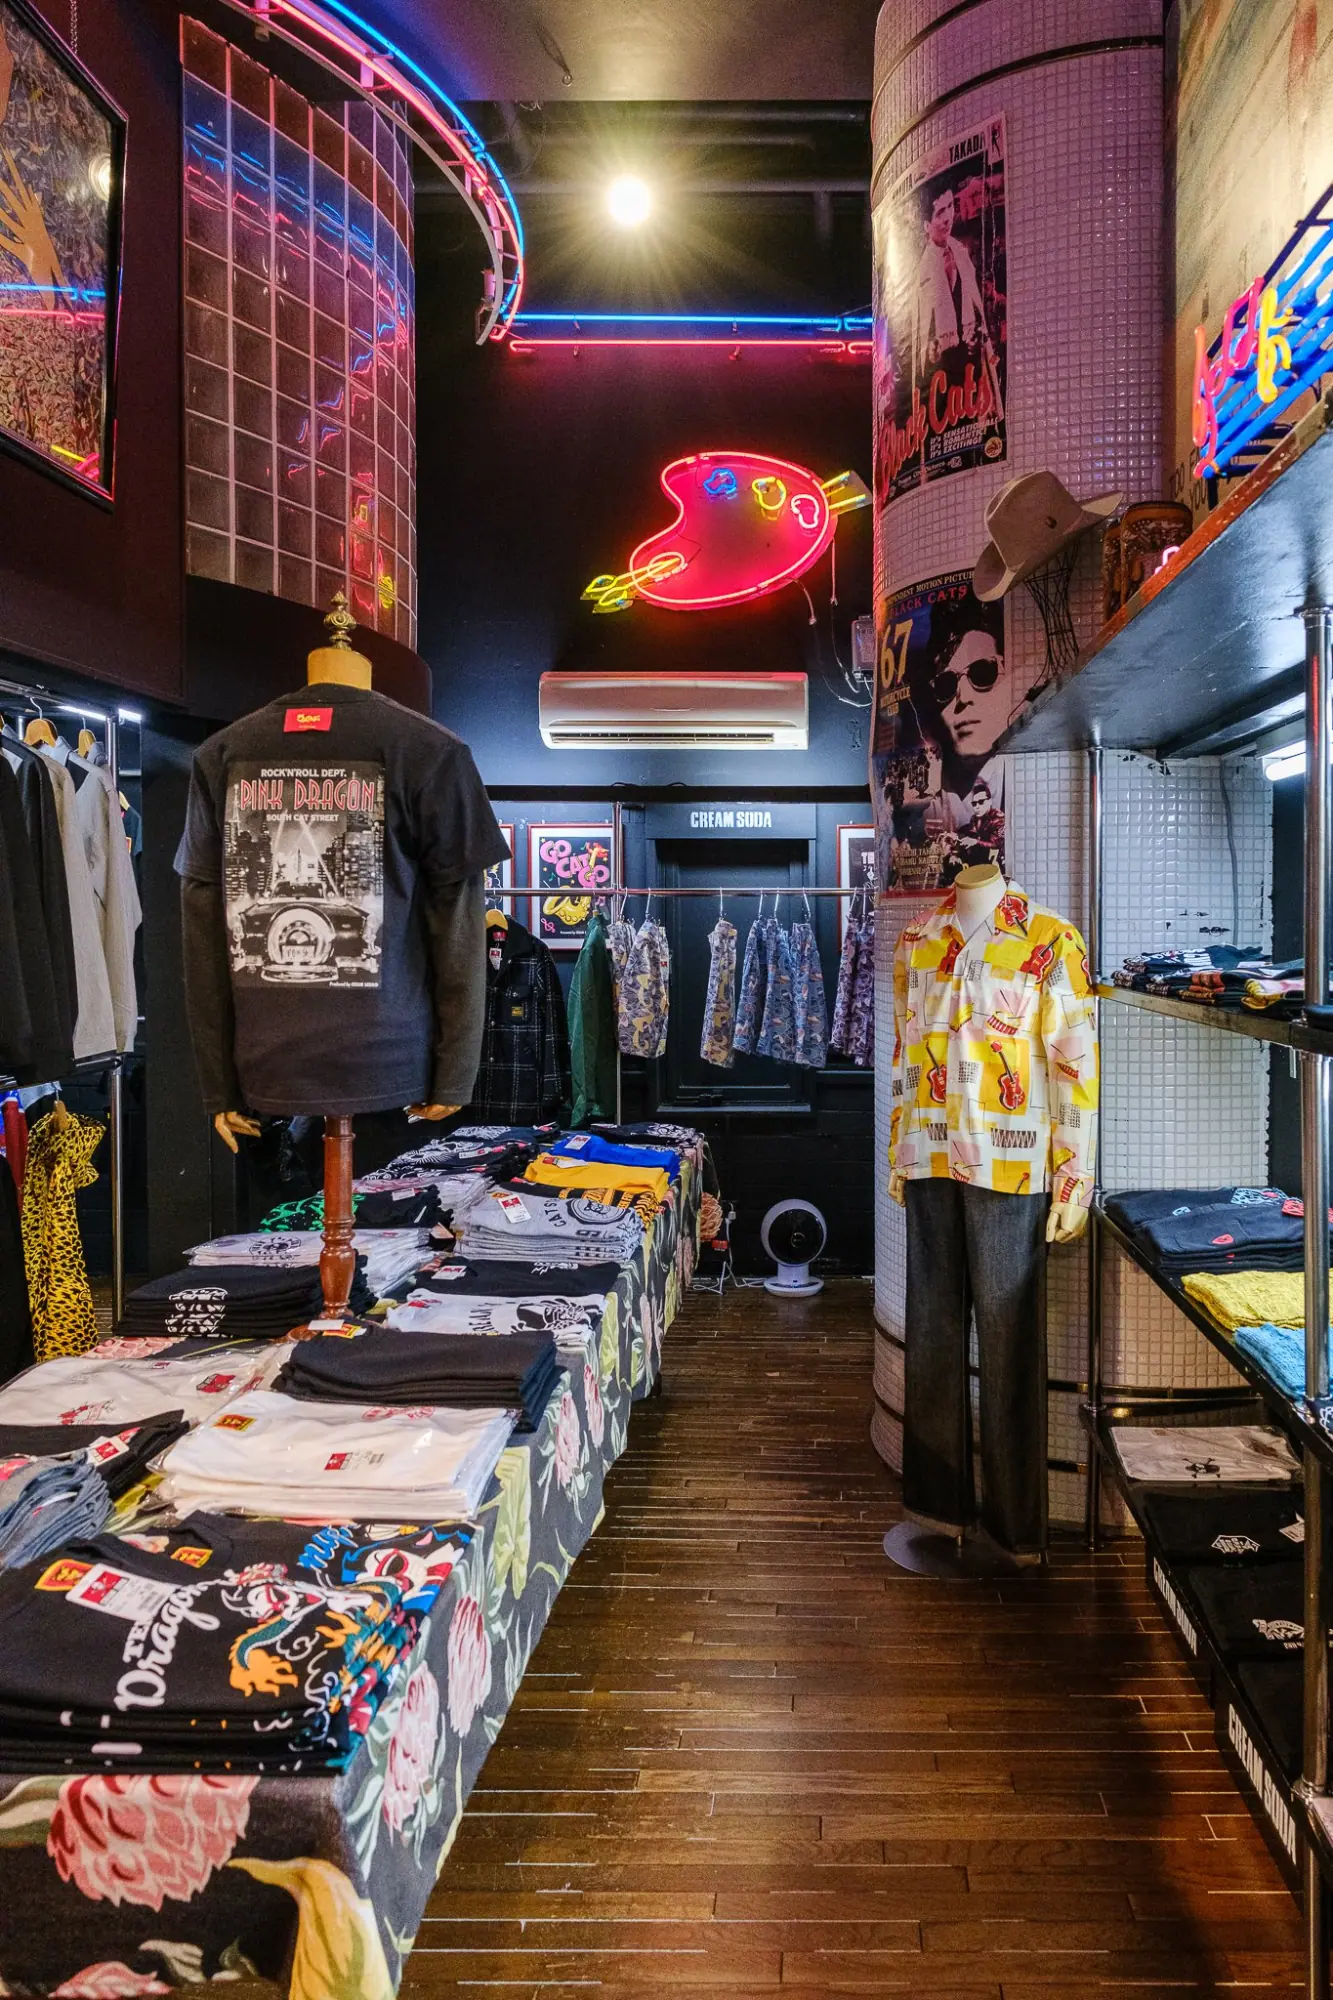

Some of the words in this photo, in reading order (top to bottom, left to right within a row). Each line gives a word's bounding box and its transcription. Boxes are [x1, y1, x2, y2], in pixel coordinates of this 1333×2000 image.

[944, 571, 974, 585] PICTUR
[881, 619, 914, 690] 67
[261, 768, 320, 778] ROCK'N'ROLL
[321, 768, 347, 778] DEPT.
[240, 778, 284, 811] PINK
[293, 778, 375, 812] DRAGON
[266, 814, 292, 822] SOUTH
[311, 814, 339, 822] STREET
[690, 811, 734, 829] CREAM
[736, 811, 772, 828] SODA
[540, 839, 572, 864] GO
[555, 853, 591, 879] CAT
[577, 864, 610, 889] GO
[1228, 1703, 1264, 1800] CREAM
[1263, 1769, 1297, 1867] SODA
